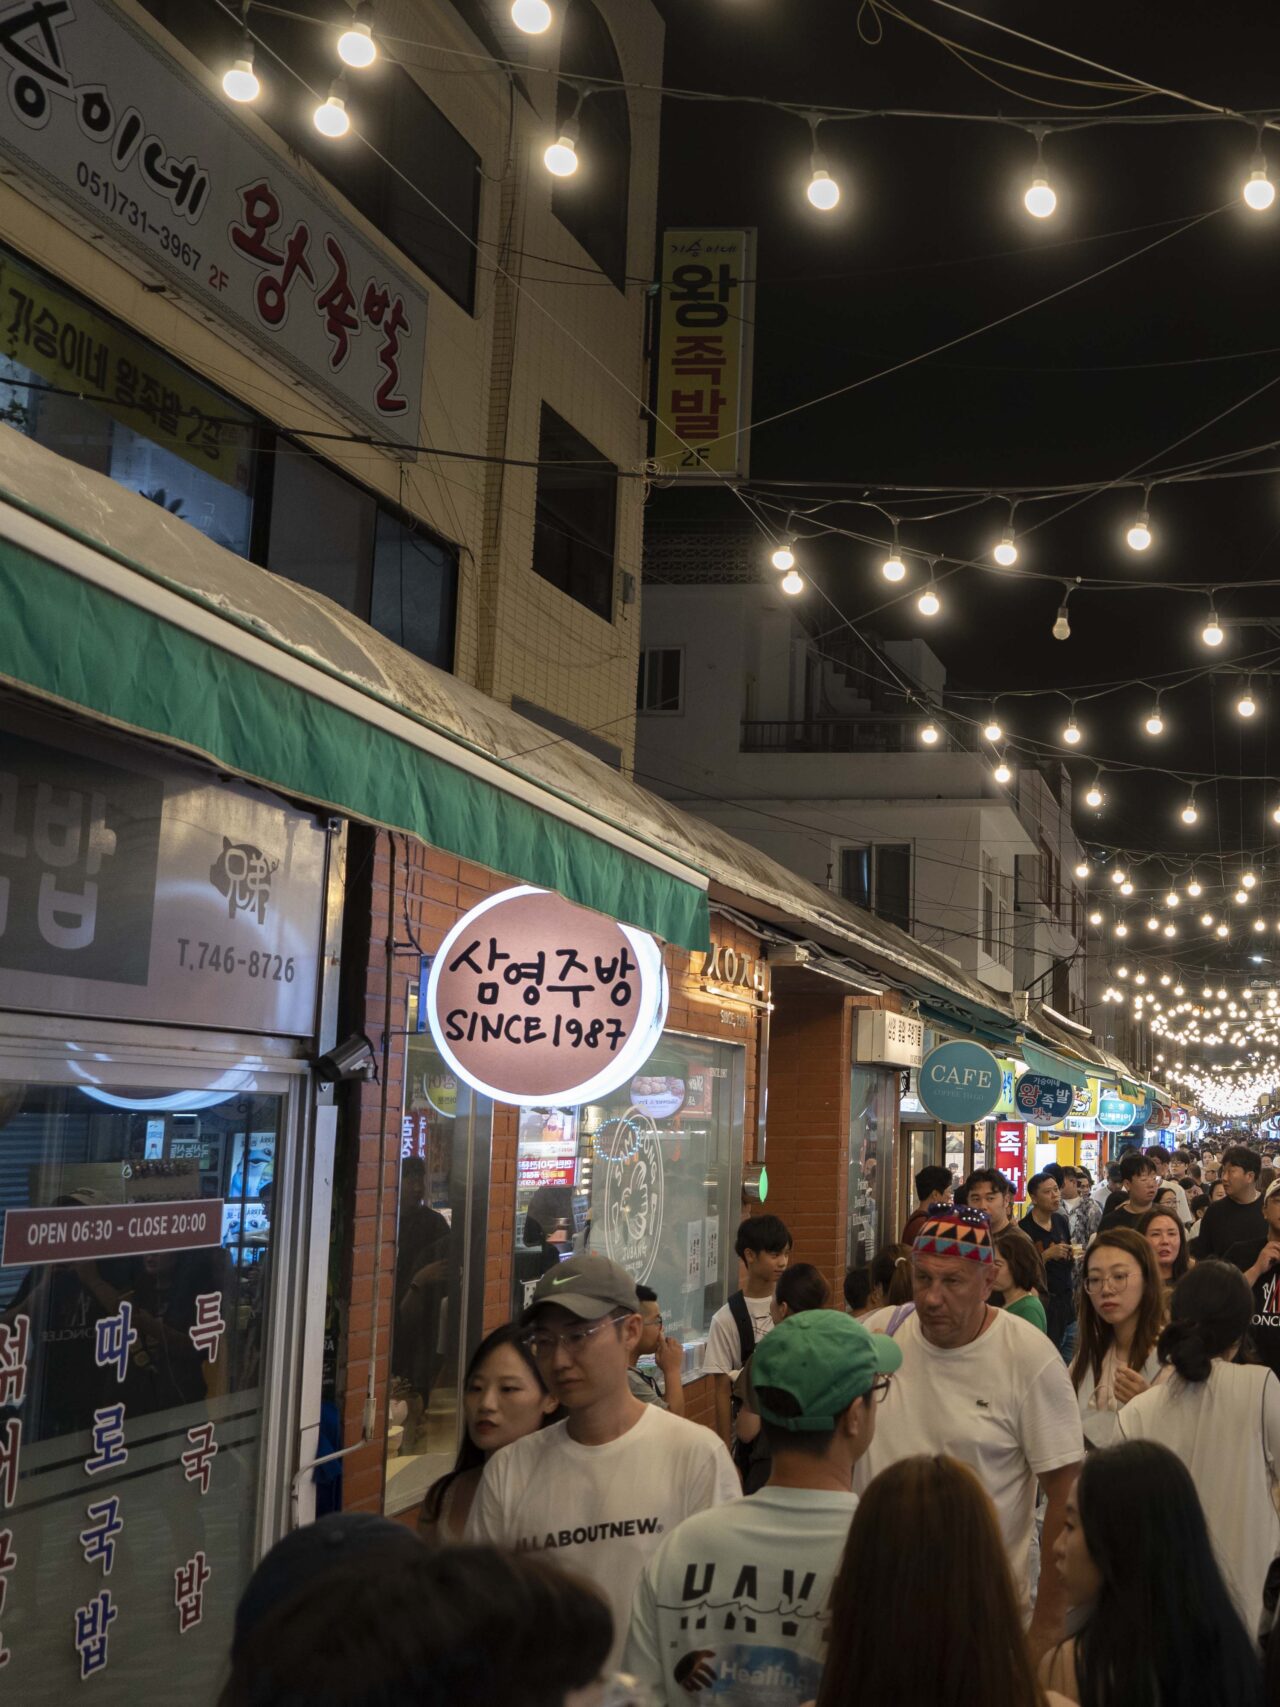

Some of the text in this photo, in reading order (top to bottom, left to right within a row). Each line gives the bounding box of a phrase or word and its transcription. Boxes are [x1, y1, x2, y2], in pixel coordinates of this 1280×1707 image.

[76, 161, 230, 293] 051)731-3967 2F
[231, 181, 410, 412] 왕족발
[667, 263, 738, 440] 왕족발
[681, 447, 711, 467] 2F
[177, 937, 295, 984] T.746-8726
[449, 937, 637, 1008] 삼영주방
[446, 1009, 626, 1050] SINCE 1987
[930, 1064, 993, 1089] CAFE
[27, 1222, 67, 1246] OPEN
[71, 1219, 112, 1242] 06:30
[127, 1215, 168, 1238] CLOSE
[171, 1212, 207, 1235] 20:00
[74, 1300, 138, 1681] 따로국밥
